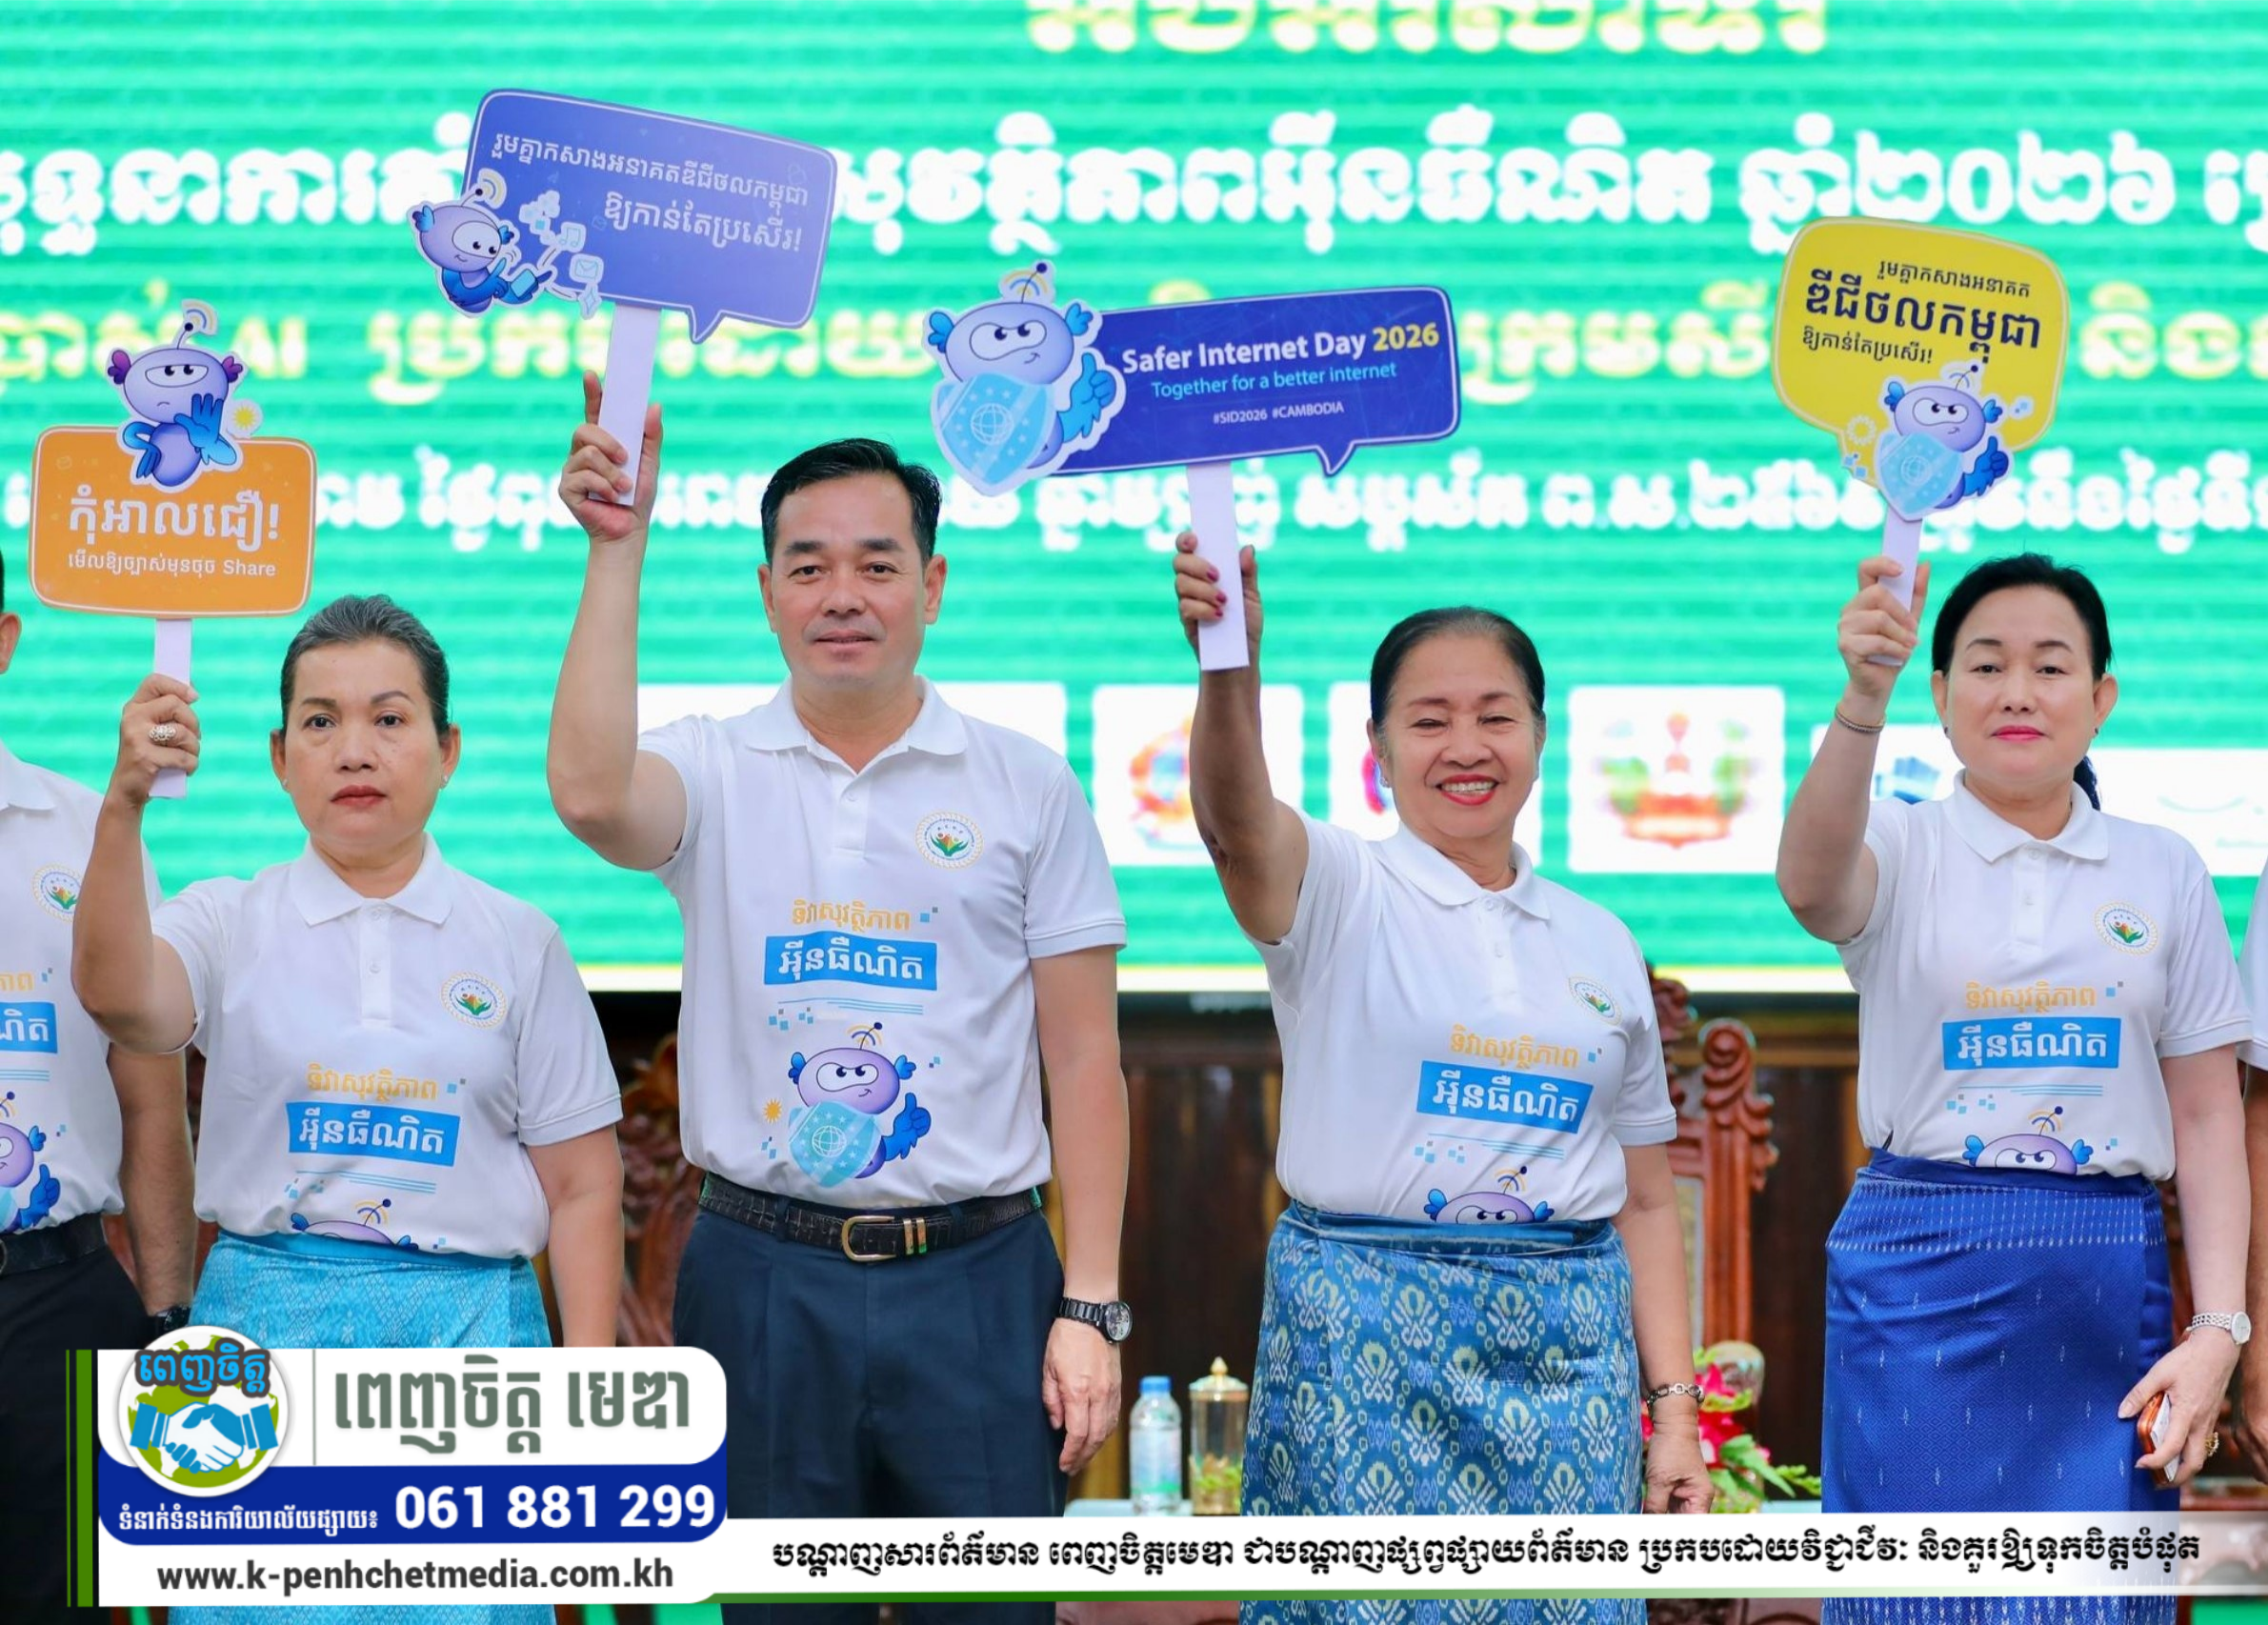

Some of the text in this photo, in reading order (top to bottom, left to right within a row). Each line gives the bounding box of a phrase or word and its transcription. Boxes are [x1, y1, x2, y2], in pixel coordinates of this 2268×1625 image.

[1122, 323, 1439, 373] Safer Internet Day 2026
[1152, 362, 1397, 400] Together for a better internet
[1214, 401, 1344, 425] #SID2026 #CAMBODIA
[70, 484, 279, 552] កុំអាលជឿ!
[223, 559, 275, 576] Share
